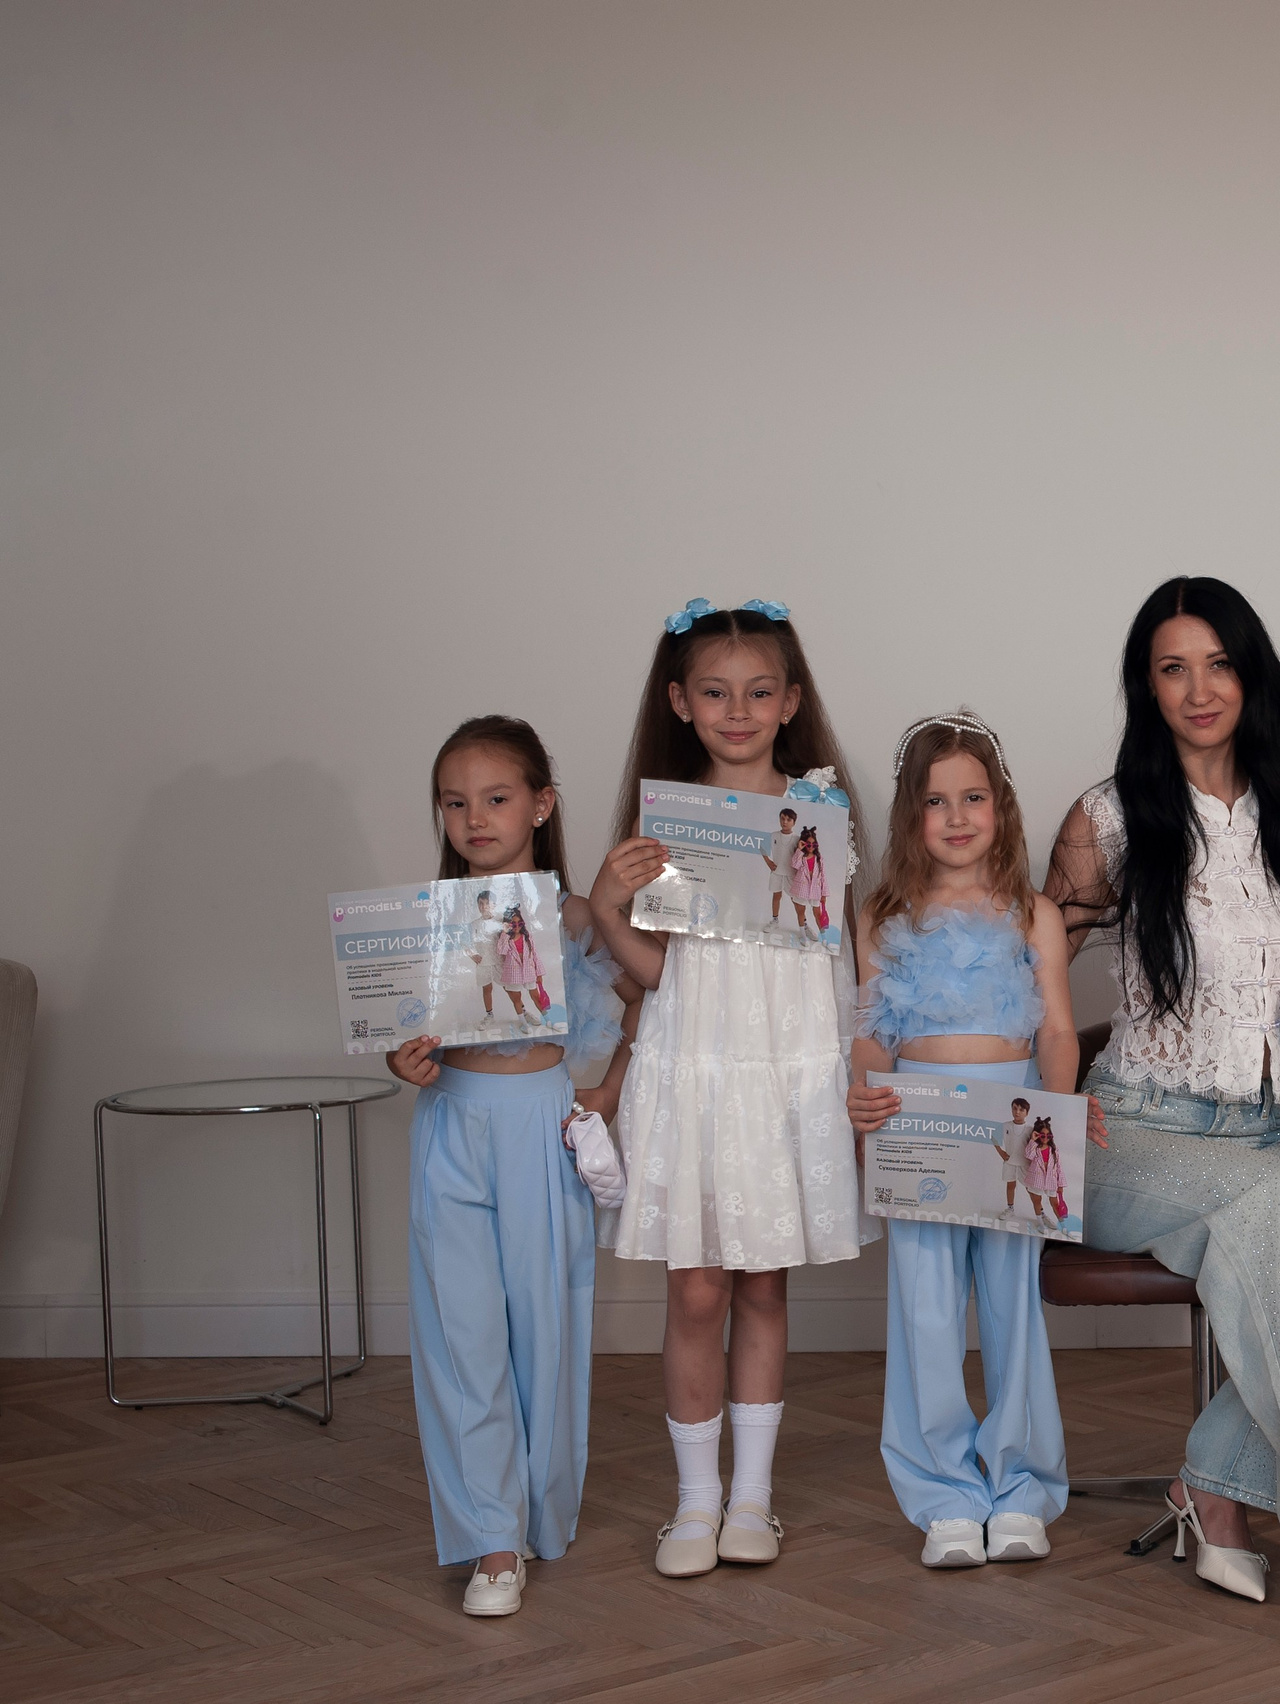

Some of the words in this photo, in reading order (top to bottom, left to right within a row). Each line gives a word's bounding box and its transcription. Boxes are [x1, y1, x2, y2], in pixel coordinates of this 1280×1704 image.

[652, 822, 765, 849] СЕРТИФИКАТ
[345, 931, 463, 954] СЕРТИФИКАТ
[348, 984, 372, 992] БАЗОВЫЙ
[388, 989, 413, 997] Милана
[880, 1118, 996, 1139] СЕРТИФИКАТ
